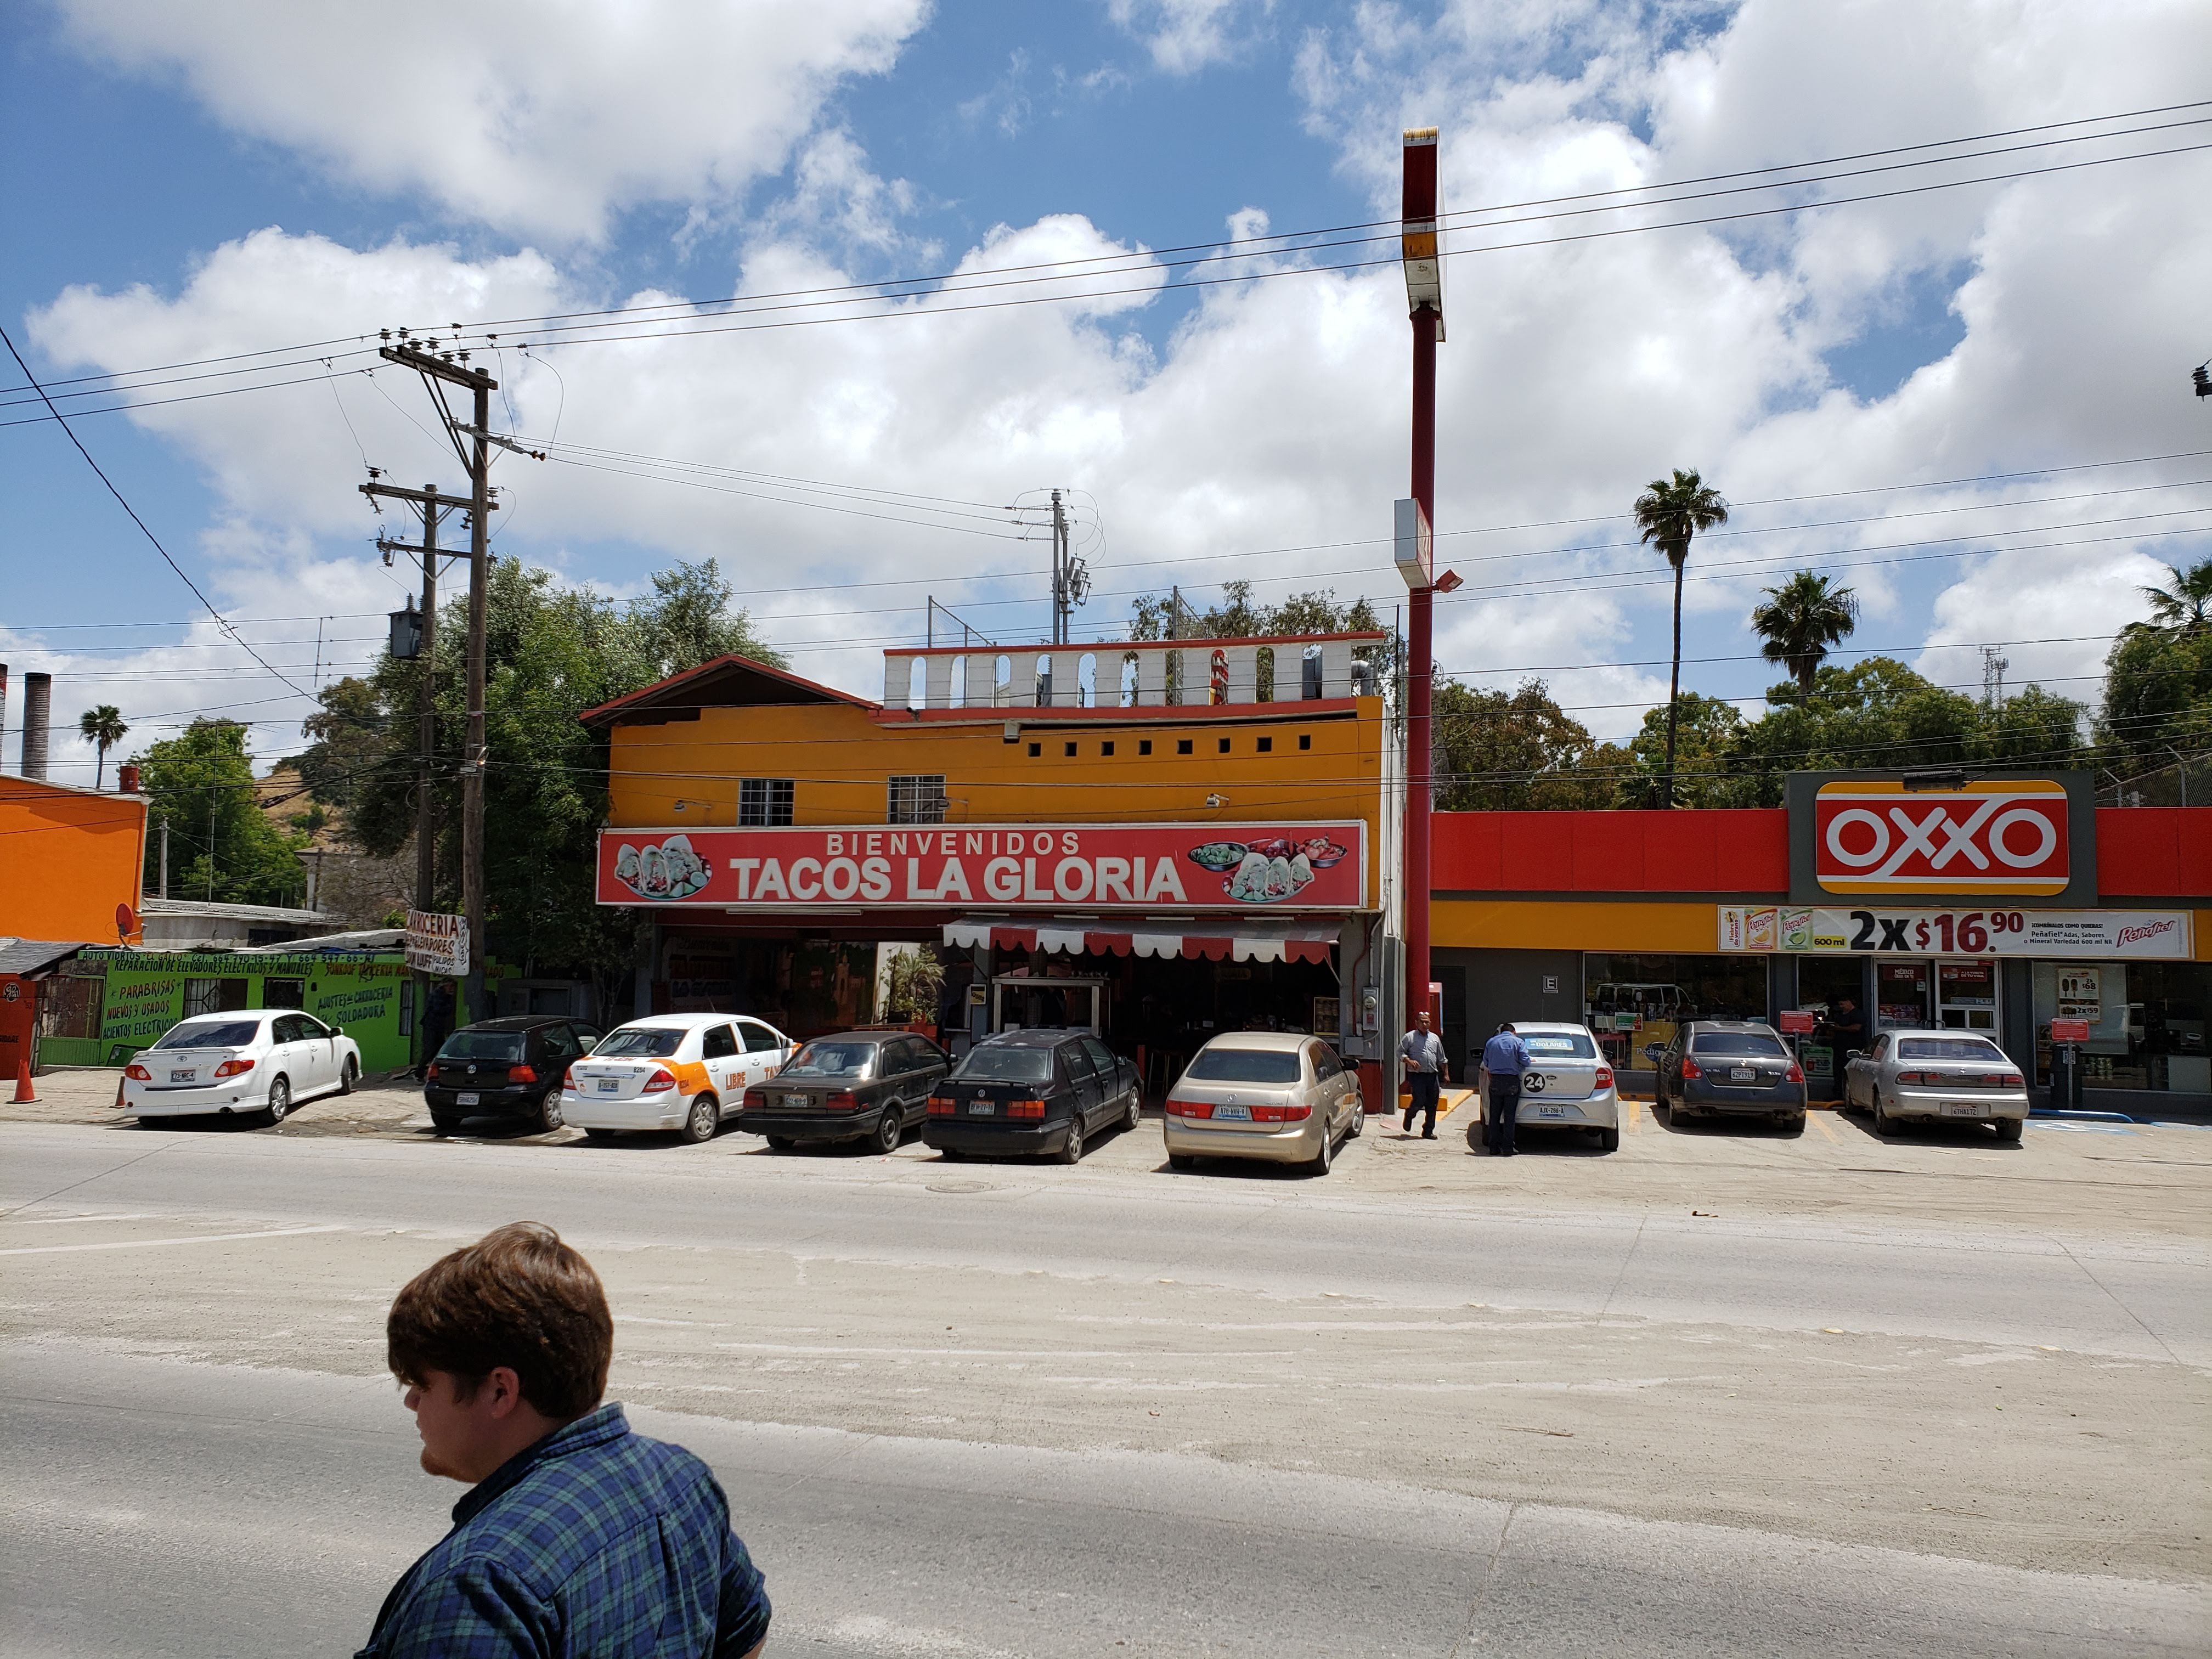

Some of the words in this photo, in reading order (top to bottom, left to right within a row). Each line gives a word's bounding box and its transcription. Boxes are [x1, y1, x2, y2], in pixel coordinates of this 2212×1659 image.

[827, 832, 1080, 856] BIENVENIDOS
[1826, 802, 2057, 874] OXXO
[730, 857, 891, 900] TACOS
[907, 857, 973, 900] LA
[984, 856, 1188, 901] GLORIA
[83, 951, 104, 960] AUTO
[107, 951, 141, 961] VIDRIOS
[115, 961, 163, 972] REPARACION
[165, 961, 174, 972] DE
[177, 962, 222, 975] ELEVADORES
[224, 962, 268, 975] ELECTRICOS
[275, 963, 314, 977] MANUALES
[119, 979, 176, 1000] PARABRISAS
[1547, 978, 1555, 989] E
[106, 1002, 132, 1020] NUEVOS
[142, 1000, 170, 1017] USADOS
[336, 1004, 386, 1026] SOLDADURA
[103, 1024, 131, 1040] ACIENTOS
[134, 1018, 178, 1036] ELECTRICOS
[1637, 1047, 1661, 1057] Pedig
[726, 1071, 746, 1091] LIBRE
[764, 1065, 782, 1080] TAX
[1526, 1076, 1544, 1088] 24
